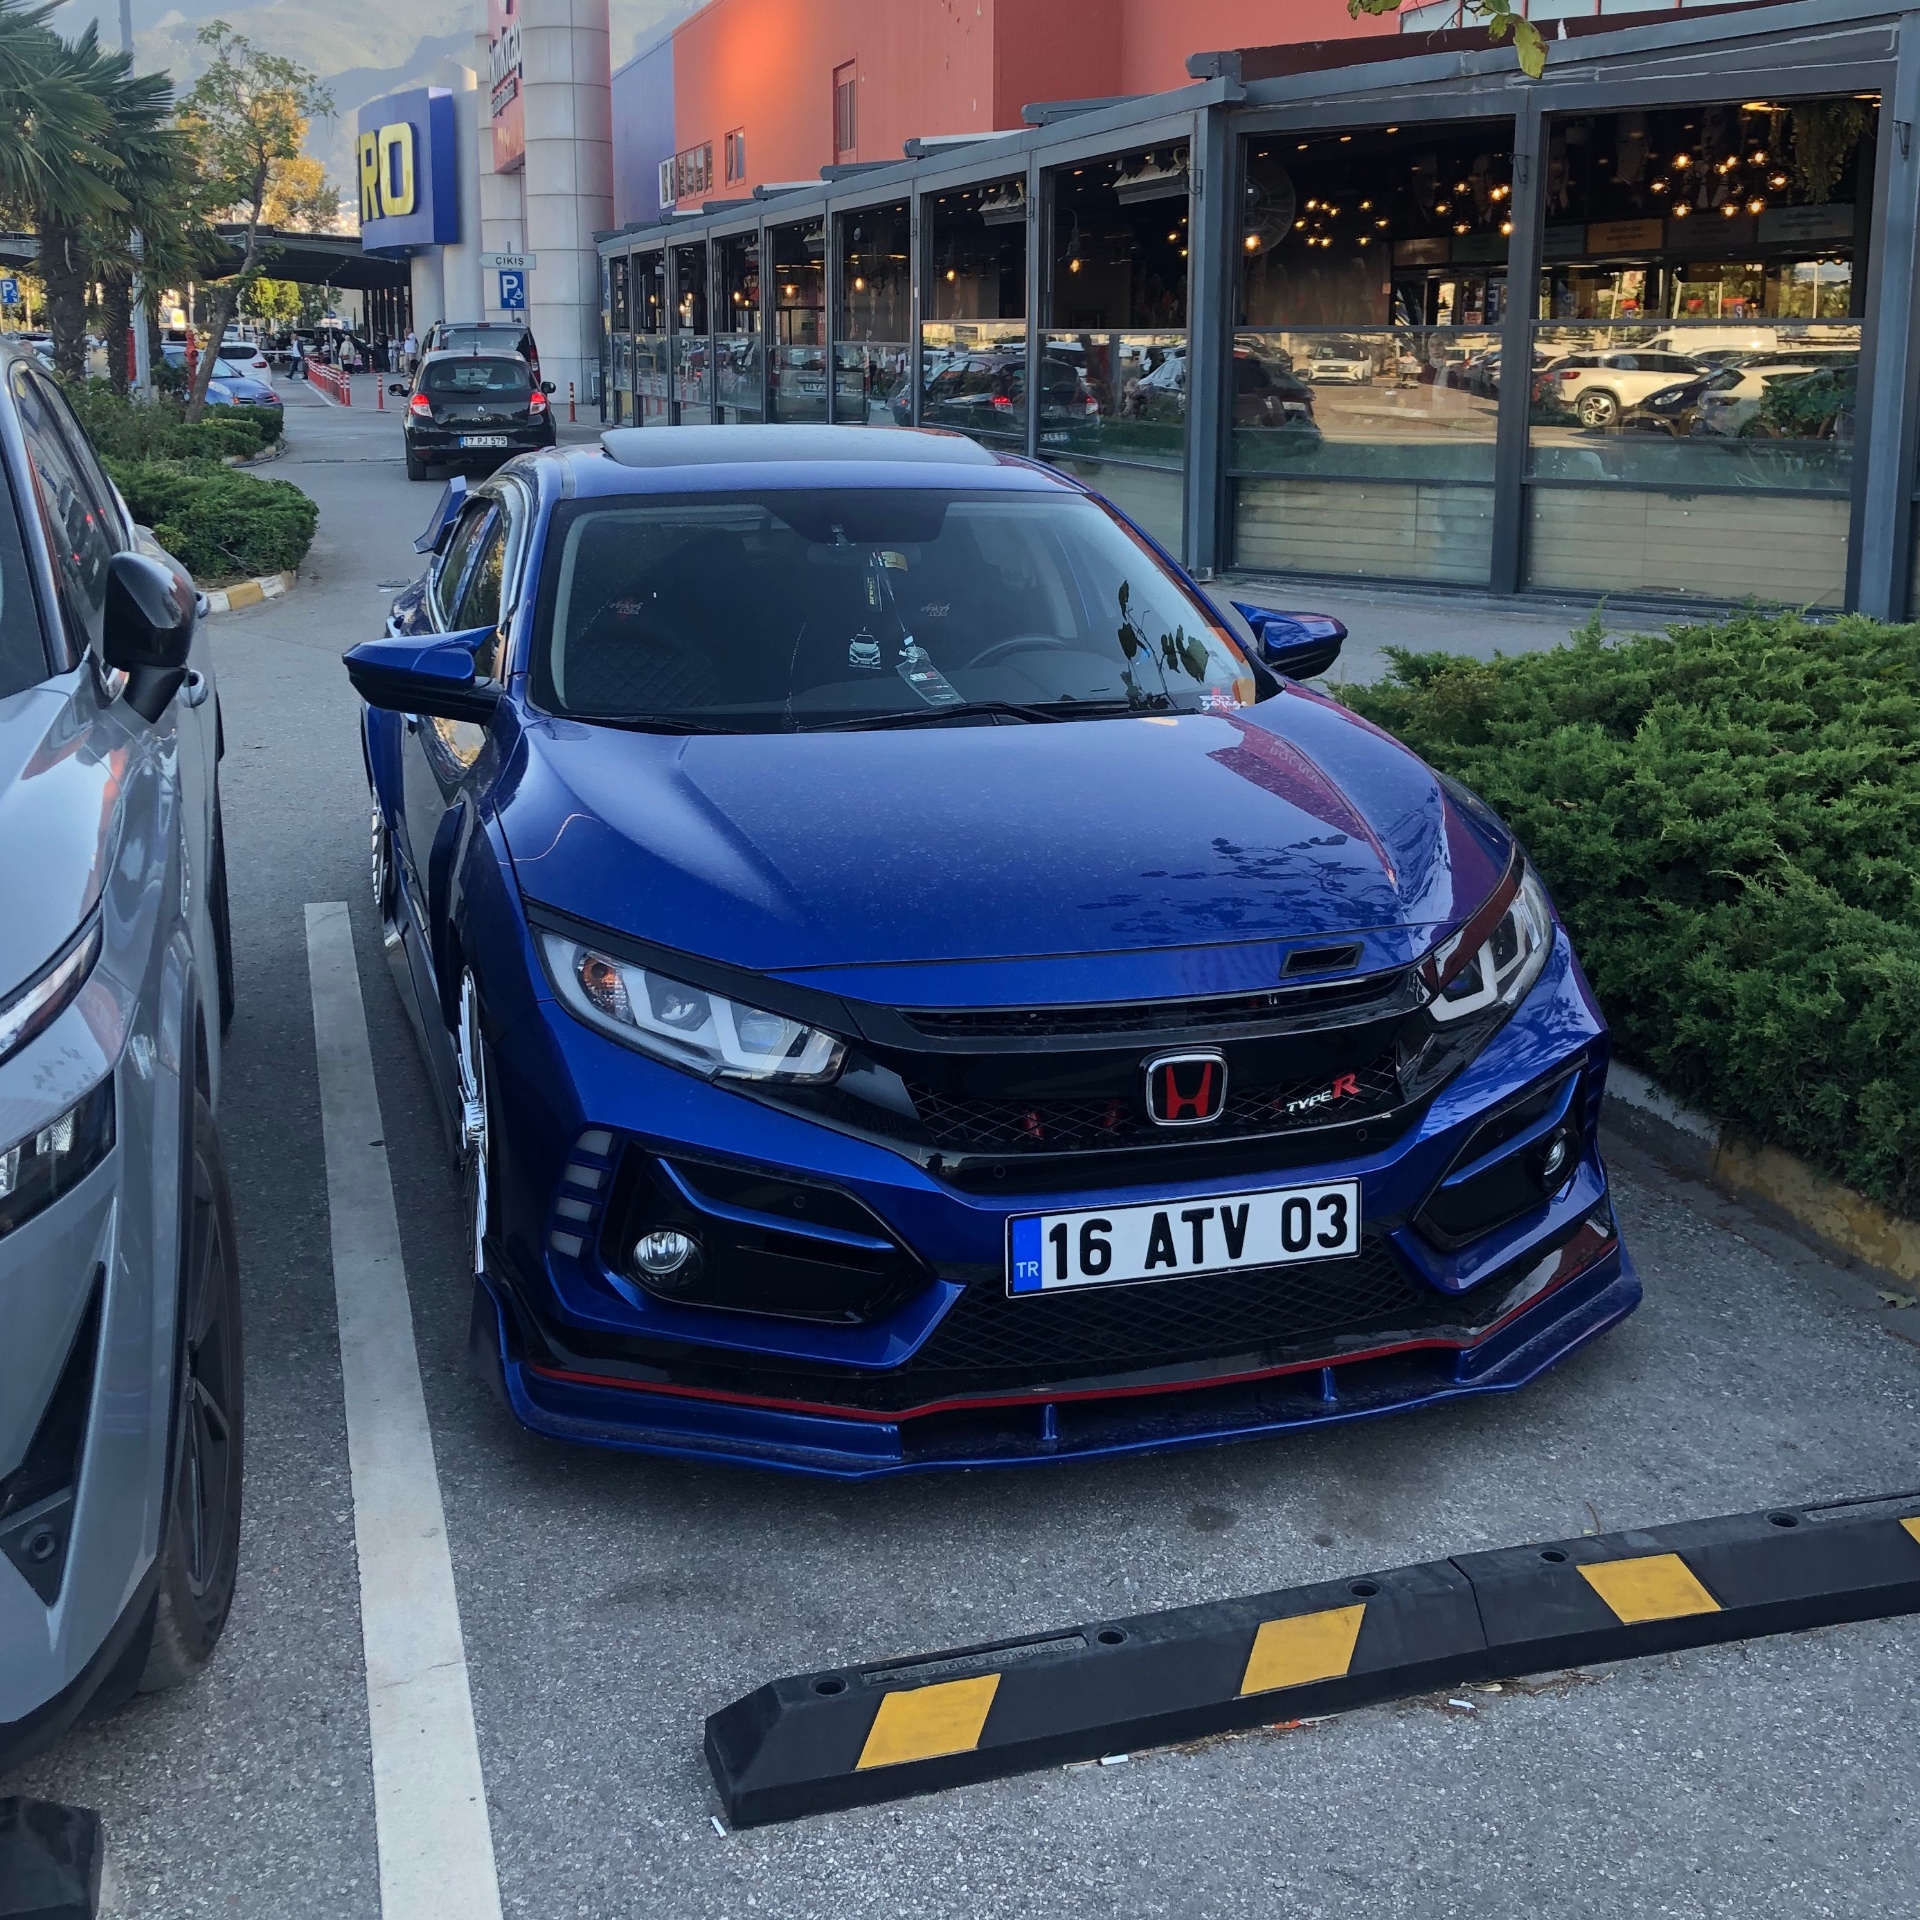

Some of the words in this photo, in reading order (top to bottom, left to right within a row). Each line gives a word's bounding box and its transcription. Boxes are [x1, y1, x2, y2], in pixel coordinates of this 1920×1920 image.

[495, 257, 524, 267] ÇIKIŞ
[2, 281, 14, 297] P
[502, 275, 518, 299] P
[1287, 1091, 1334, 1113] TYPE
[1331, 1072, 1361, 1099] R
[1016, 1260, 1039, 1279] TR
[1049, 1218, 1113, 1280] 16
[1144, 1203, 1250, 1270] ATV
[1281, 1192, 1348, 1253] 03
